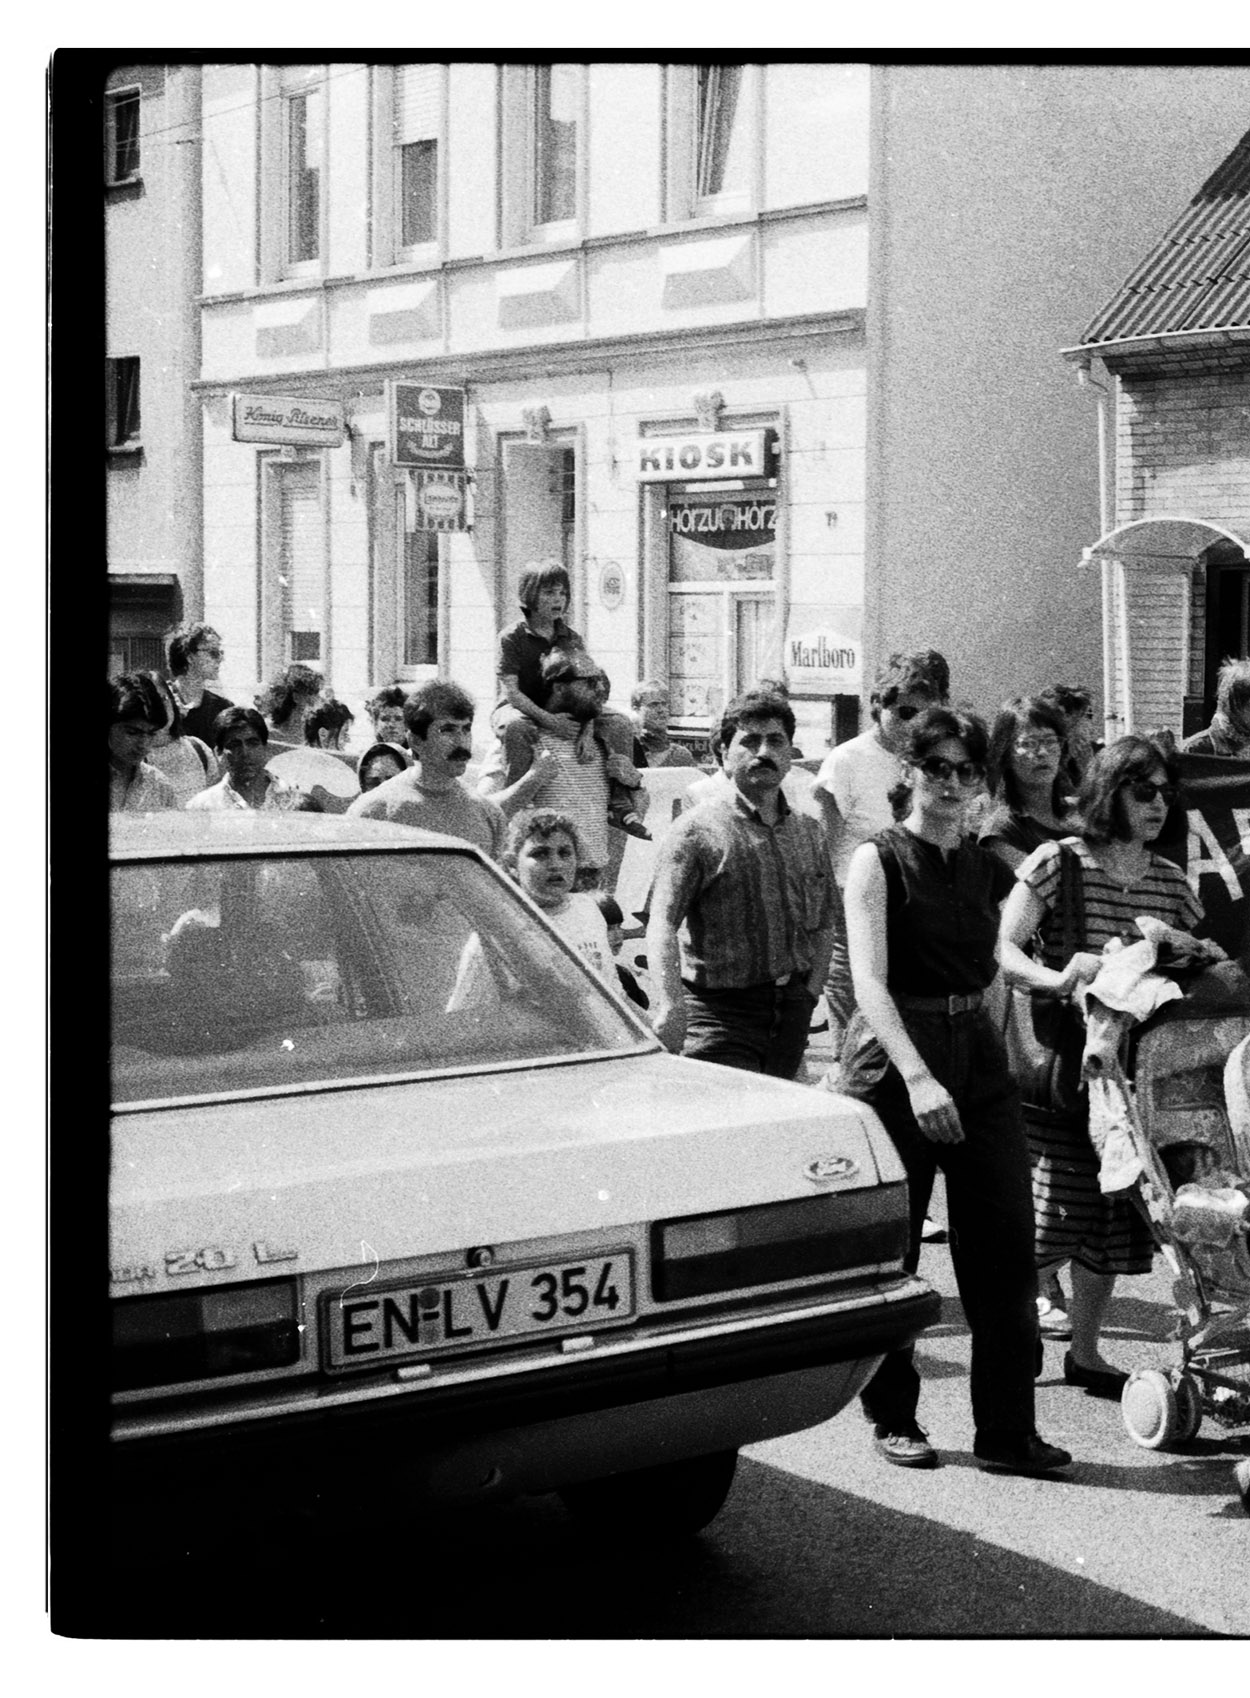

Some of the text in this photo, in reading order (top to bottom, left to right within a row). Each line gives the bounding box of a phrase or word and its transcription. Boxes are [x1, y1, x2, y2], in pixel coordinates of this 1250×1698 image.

[640, 441, 753, 472] KIOSK
[791, 636, 855, 668] Marlboro
[343, 1261, 620, 1355] EN-LV 354
